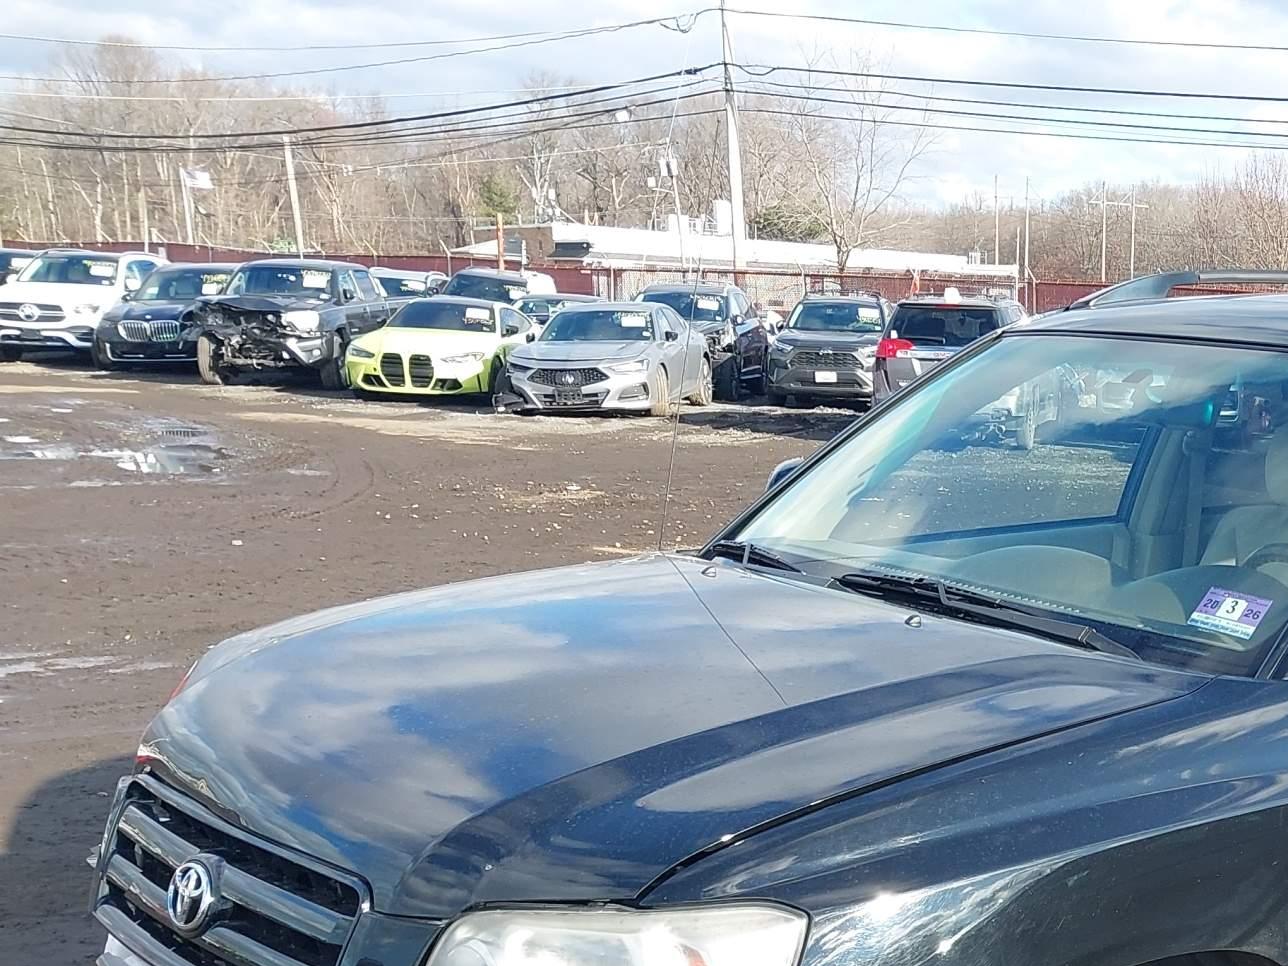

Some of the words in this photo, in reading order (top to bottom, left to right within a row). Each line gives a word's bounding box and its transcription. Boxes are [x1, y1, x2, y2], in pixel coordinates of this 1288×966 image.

[1203, 598, 1219, 609] 20
[1226, 600, 1239, 614] 3
[1244, 609, 1262, 620] 26
